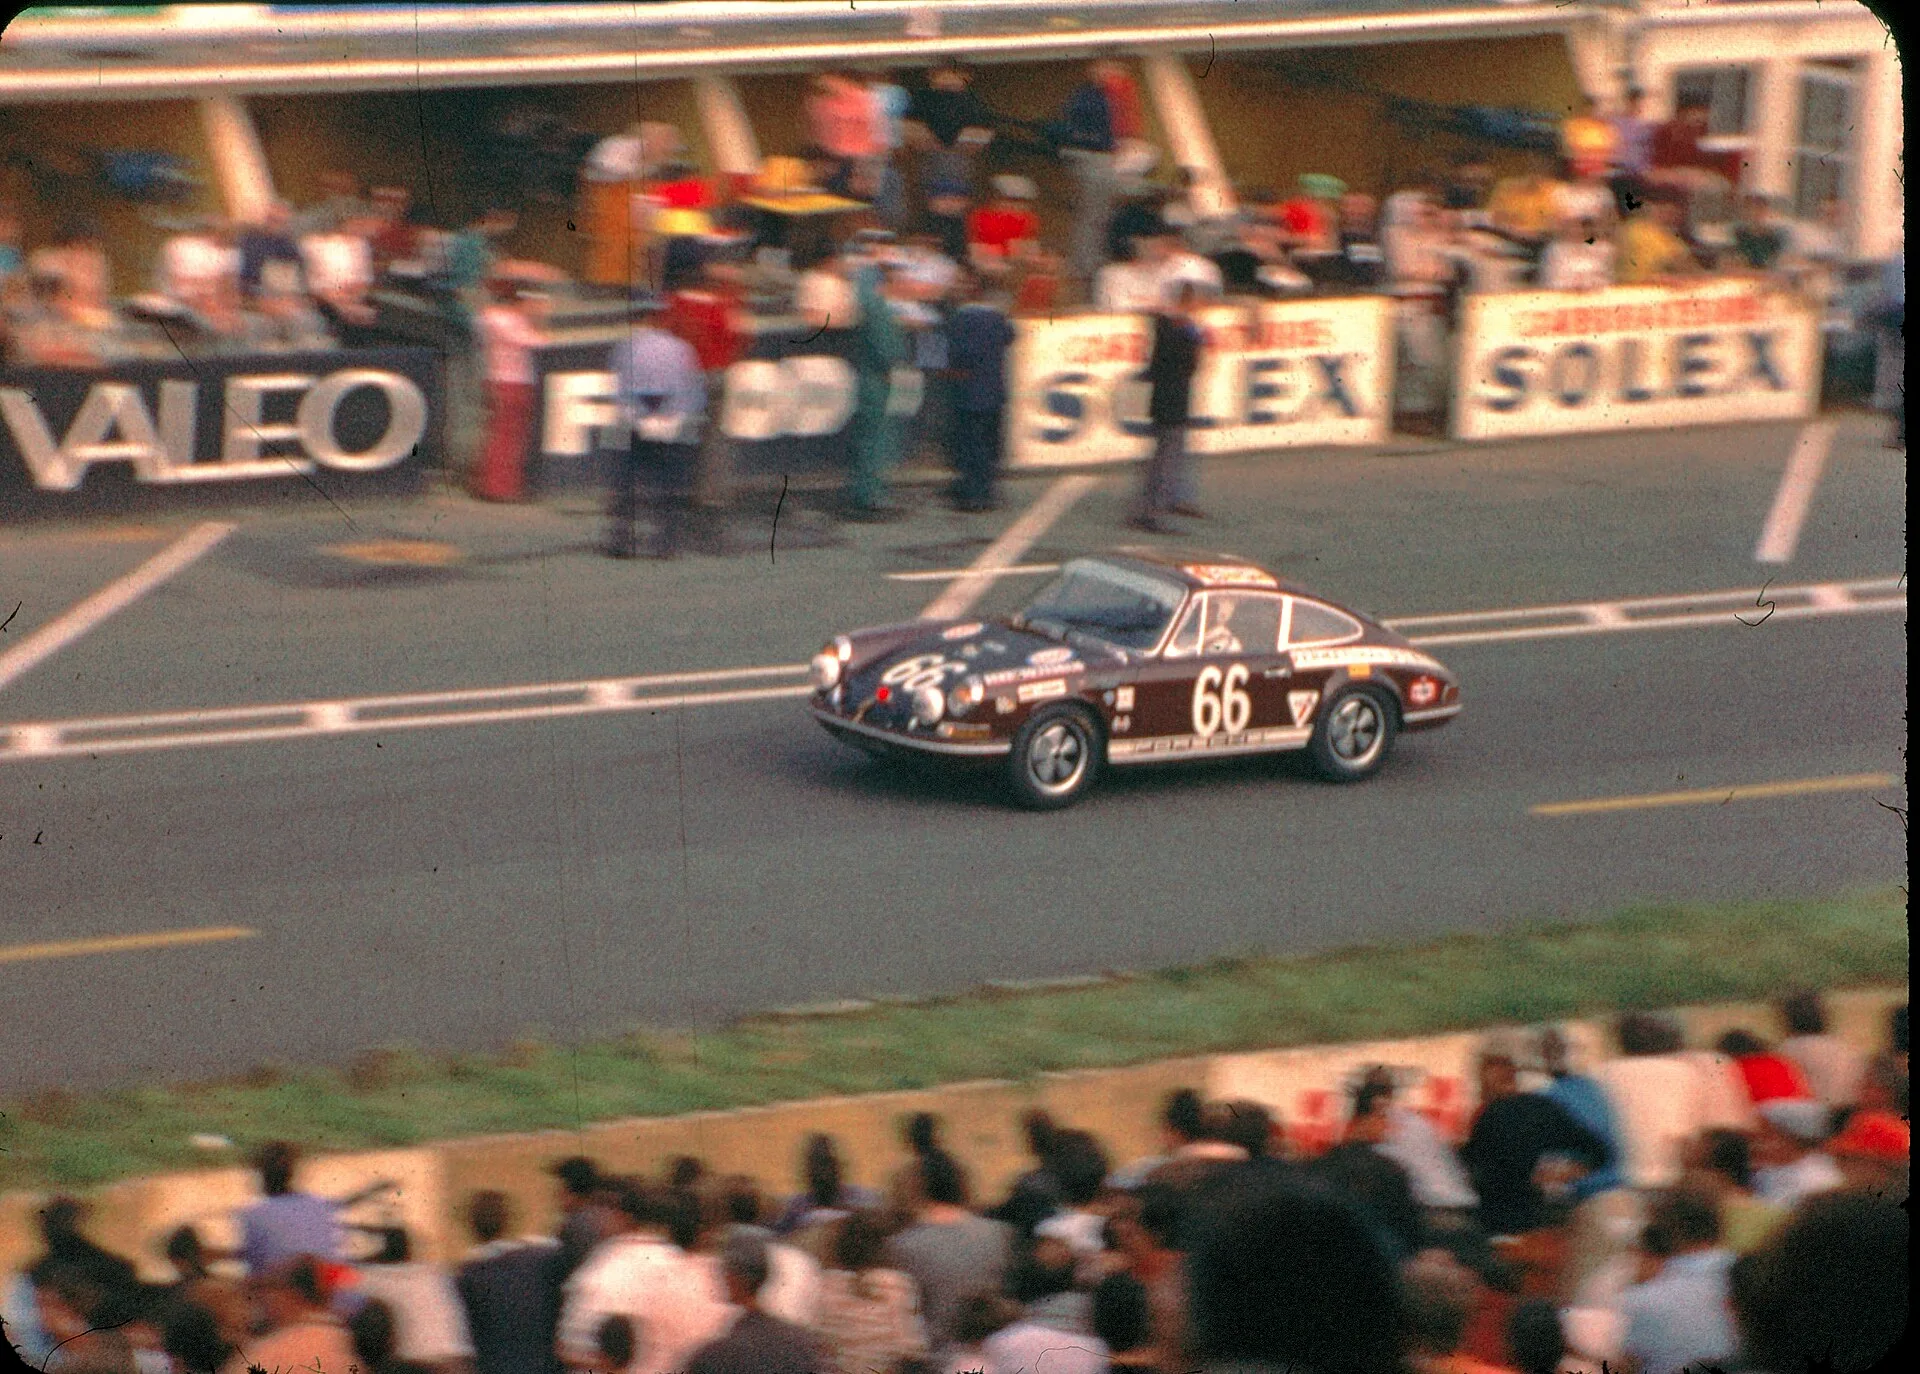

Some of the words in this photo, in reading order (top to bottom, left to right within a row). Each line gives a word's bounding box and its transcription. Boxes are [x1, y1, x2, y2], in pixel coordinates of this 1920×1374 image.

[1487, 328, 1785, 412] SOLEX
[0, 369, 427, 491] VALEO
[1192, 663, 1251, 737] 66
